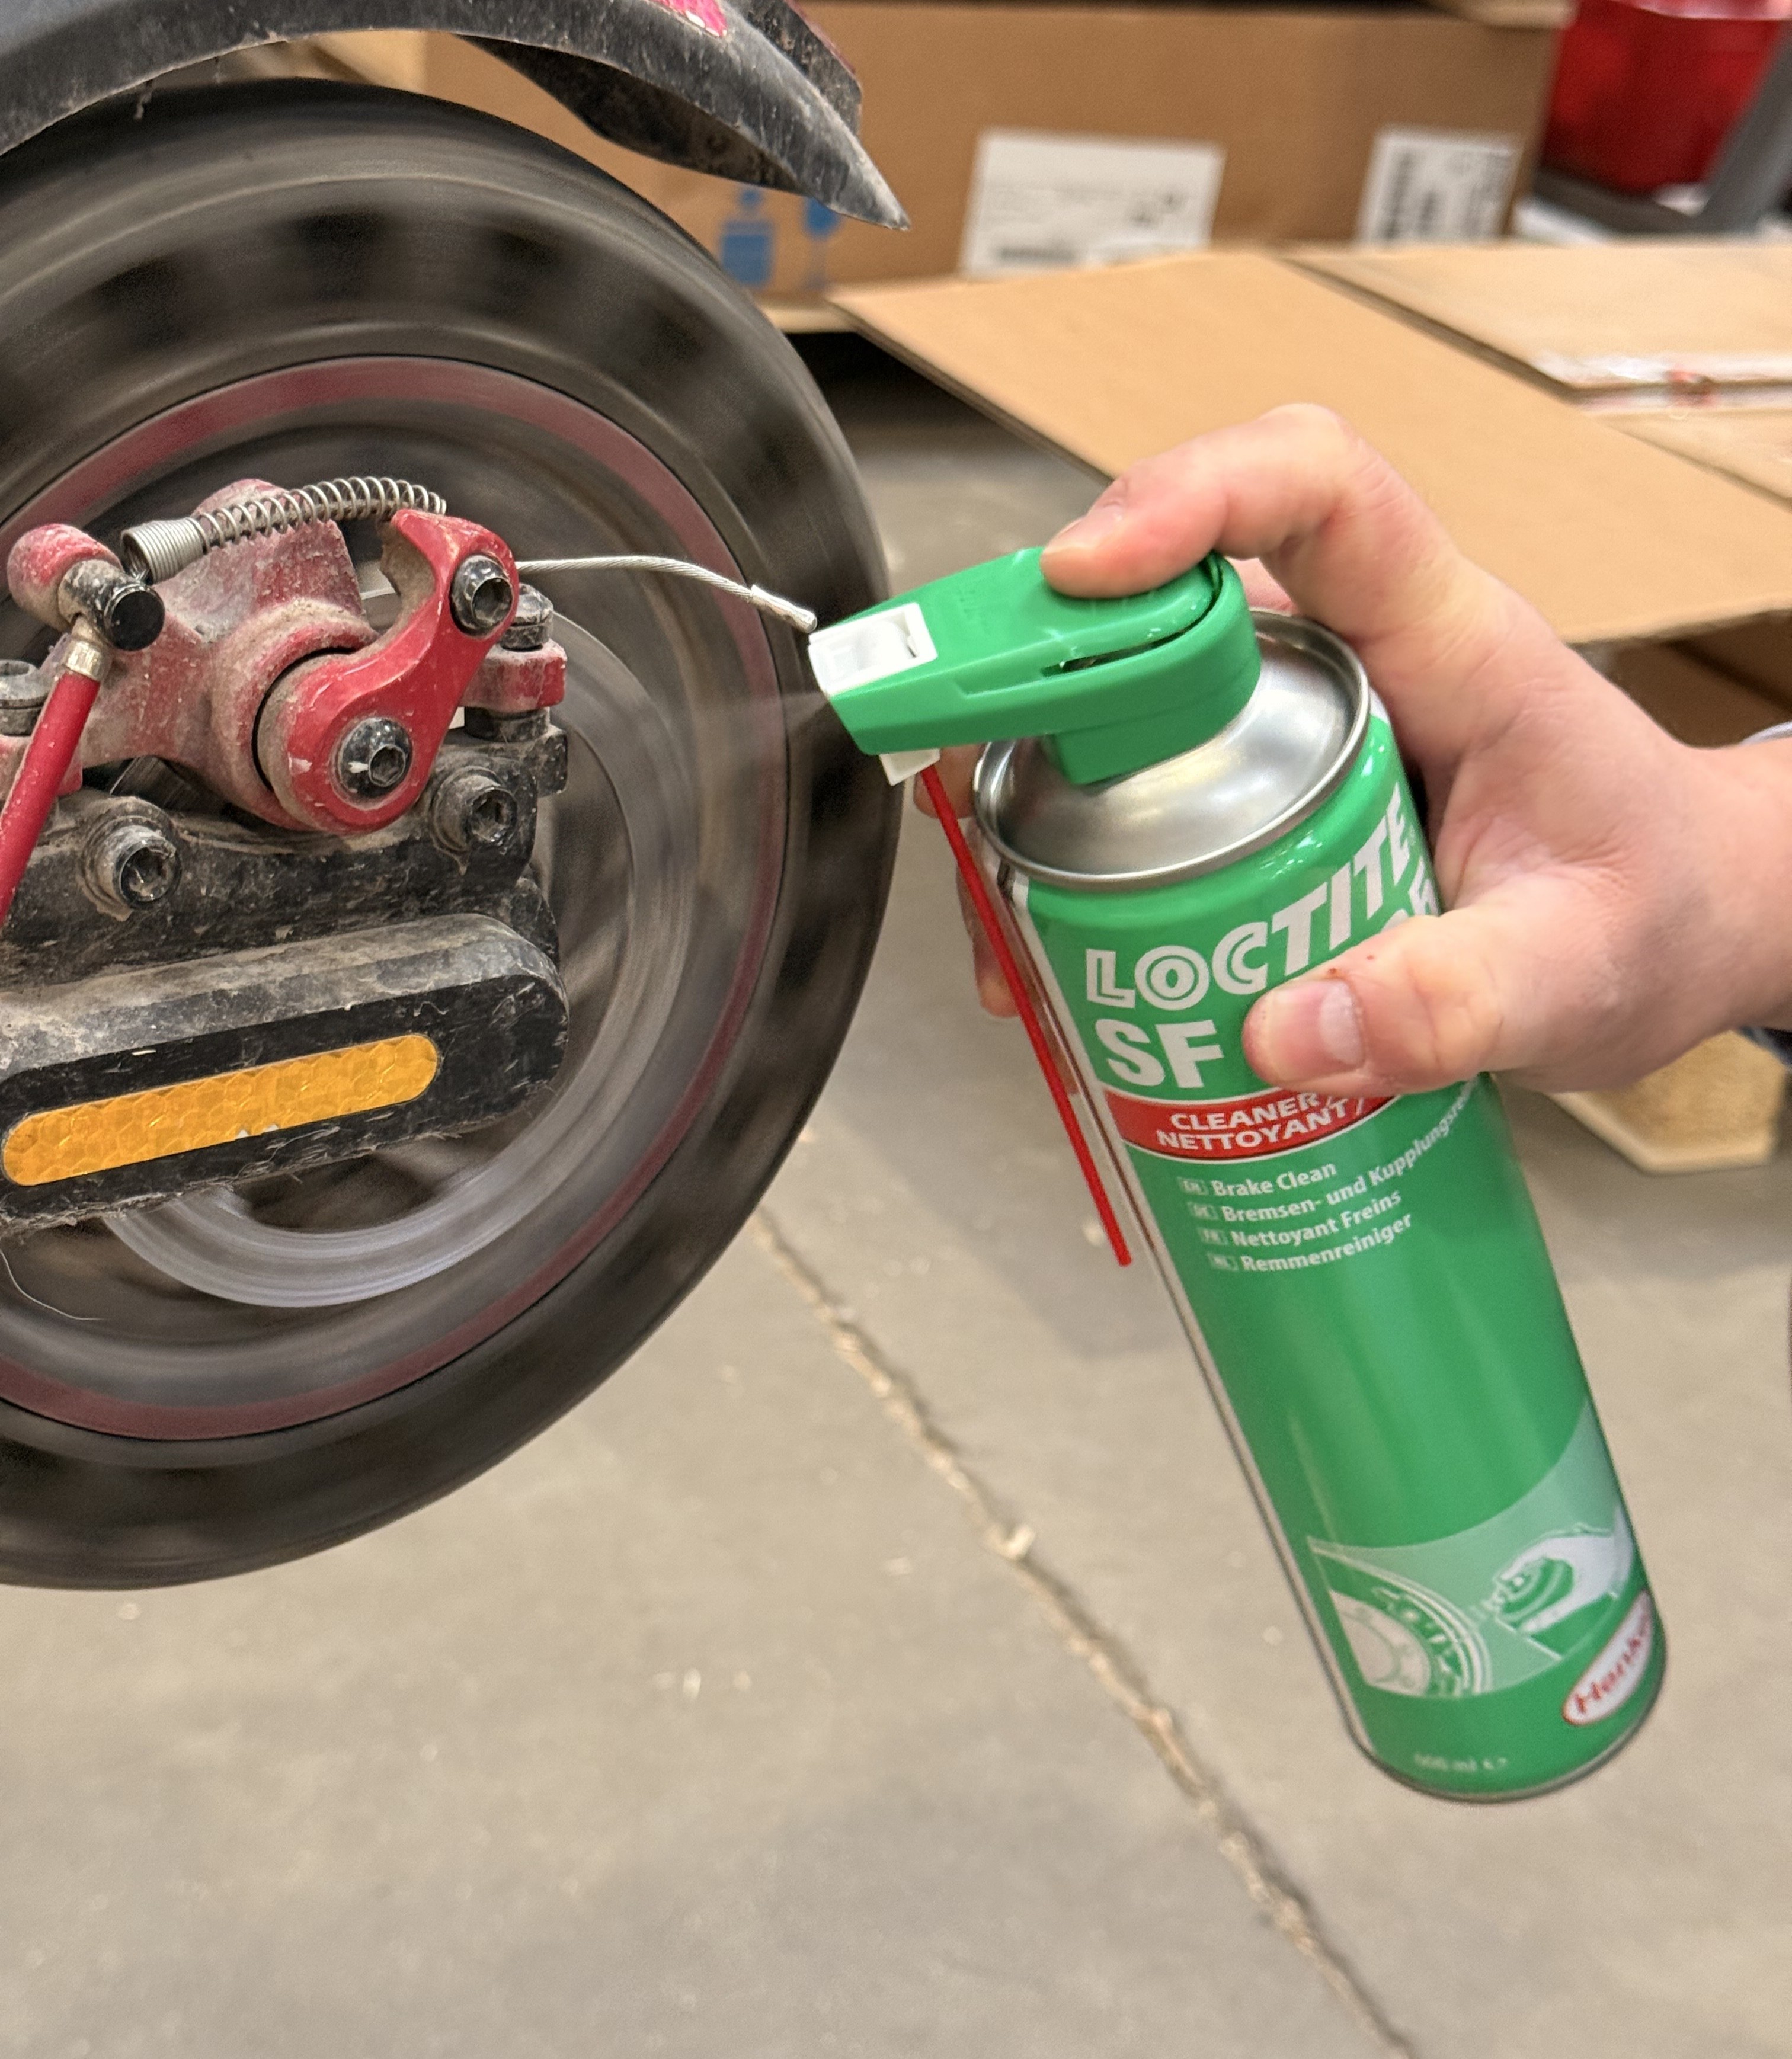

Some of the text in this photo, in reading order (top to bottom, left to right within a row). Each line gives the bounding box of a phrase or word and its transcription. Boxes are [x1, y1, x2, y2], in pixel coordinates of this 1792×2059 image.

[1086, 782, 1410, 1010] LOCTITE
[1095, 1019, 1224, 1088] SF
[1156, 1098, 1349, 1151] NETTOYANT
[1171, 1092, 1320, 1130] CLEANER
[1211, 1179, 1275, 1196] Brake
[1276, 1163, 1337, 1190] Clean
[1221, 1199, 1322, 1222] Bremsen-
[1326, 1174, 1367, 1206] und
[1231, 1218, 1339, 1247] Nettoyant
[1340, 1189, 1402, 1229] Freins
[1240, 1212, 1412, 1272] Remmenreiniger
